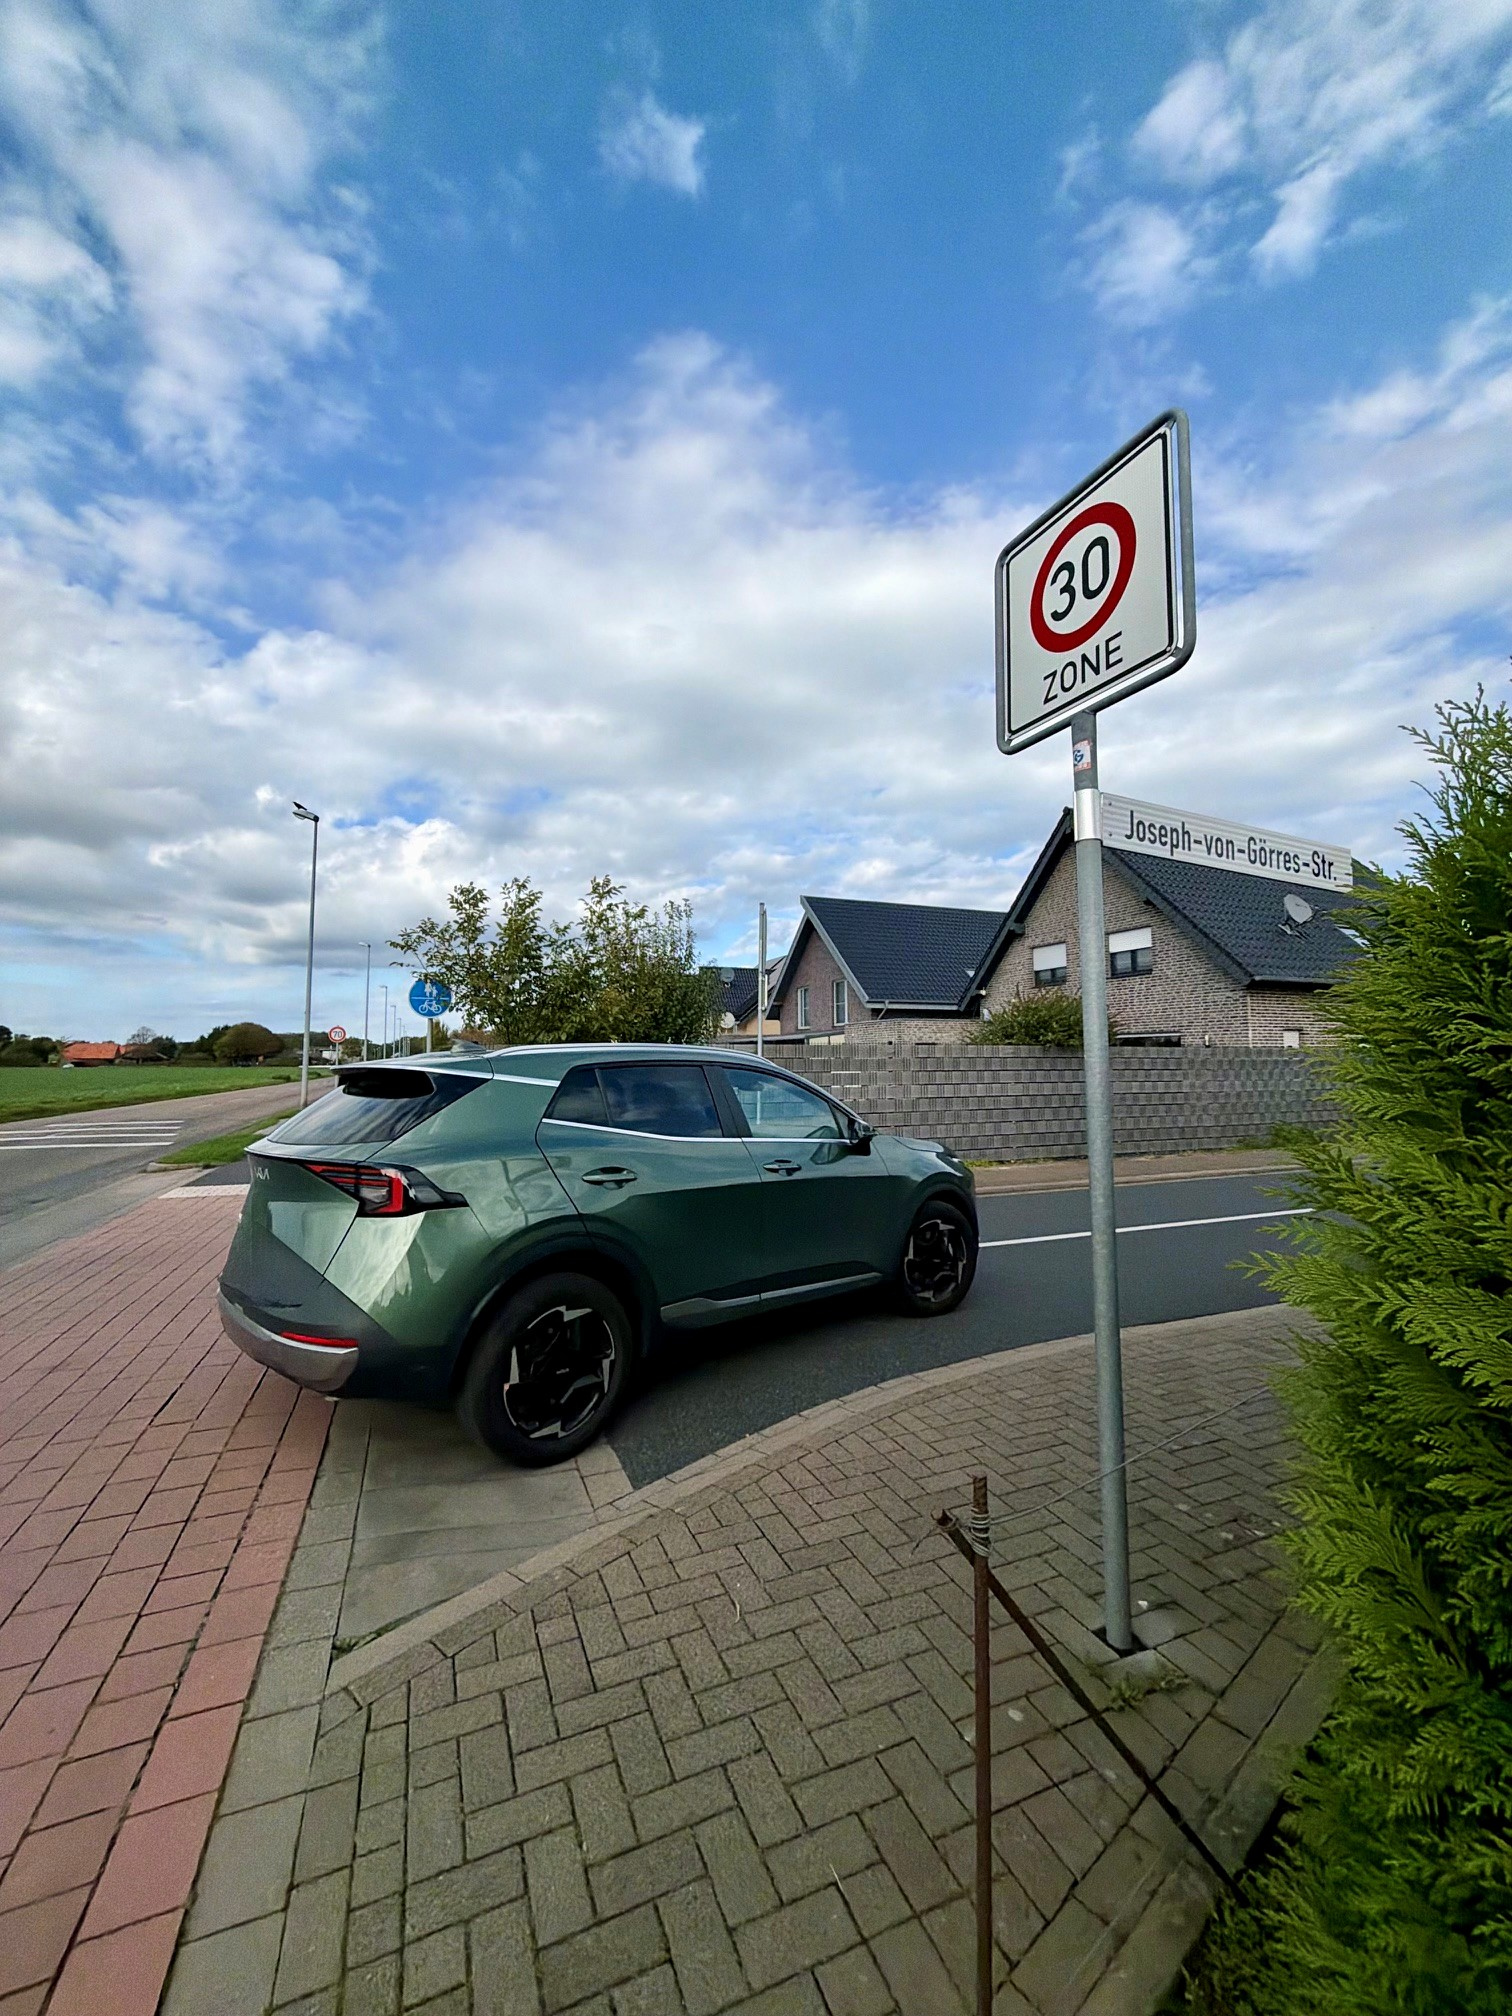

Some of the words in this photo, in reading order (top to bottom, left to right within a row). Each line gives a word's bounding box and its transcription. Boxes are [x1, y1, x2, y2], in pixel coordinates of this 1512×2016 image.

[1050, 535, 1110, 622] 30
[1042, 630, 1124, 705] ZONE
[1125, 809, 1337, 881] Joseph-von-Görres-Str.
[332, 1030, 343, 1039] 70
